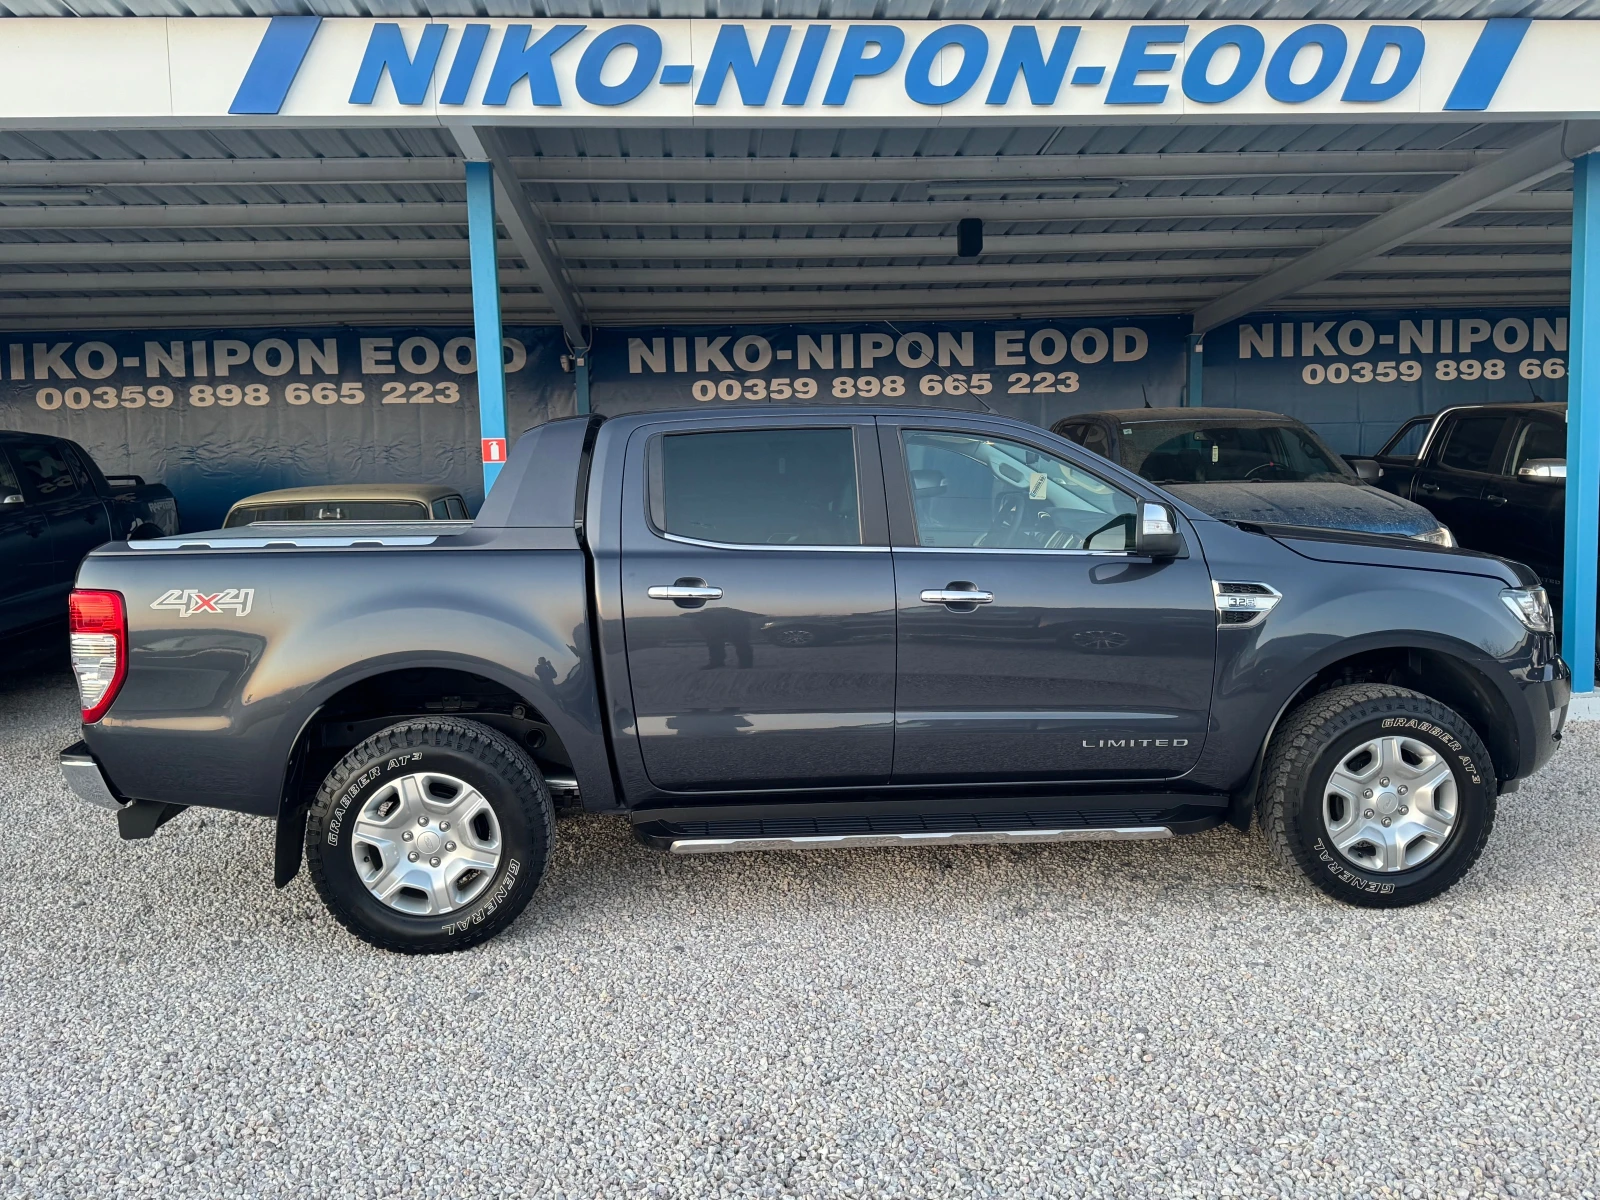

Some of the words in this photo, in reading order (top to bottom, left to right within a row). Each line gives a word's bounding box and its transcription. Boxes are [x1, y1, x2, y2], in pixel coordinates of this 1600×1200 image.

[348, 22, 1426, 106] NIKO-NIPON-EOOD
[0, 337, 339, 381] IKO-NIPON
[628, 331, 975, 374] NIKO-NIPON
[995, 327, 1149, 365] EOOD
[1238, 317, 1568, 359] NIKO-NIPON
[691, 377, 818, 402] 00359
[831, 375, 906, 399] 898
[919, 373, 993, 396] 665
[1007, 371, 1080, 394] 223
[1302, 360, 1422, 385] 00359
[1435, 358, 1506, 381] 898
[1518, 358, 1570, 380] 66
[35, 385, 174, 410] 00359
[189, 383, 270, 407] 898
[284, 382, 365, 405] 665
[381, 381, 460, 404] 223
[1082, 738, 1189, 748] LIMITED
[1381, 717, 1462, 752] GRABBER
[327, 766, 381, 847] GRABBER
[1313, 837, 1395, 894] GENERAL
[441, 858, 521, 936] GENERAL
